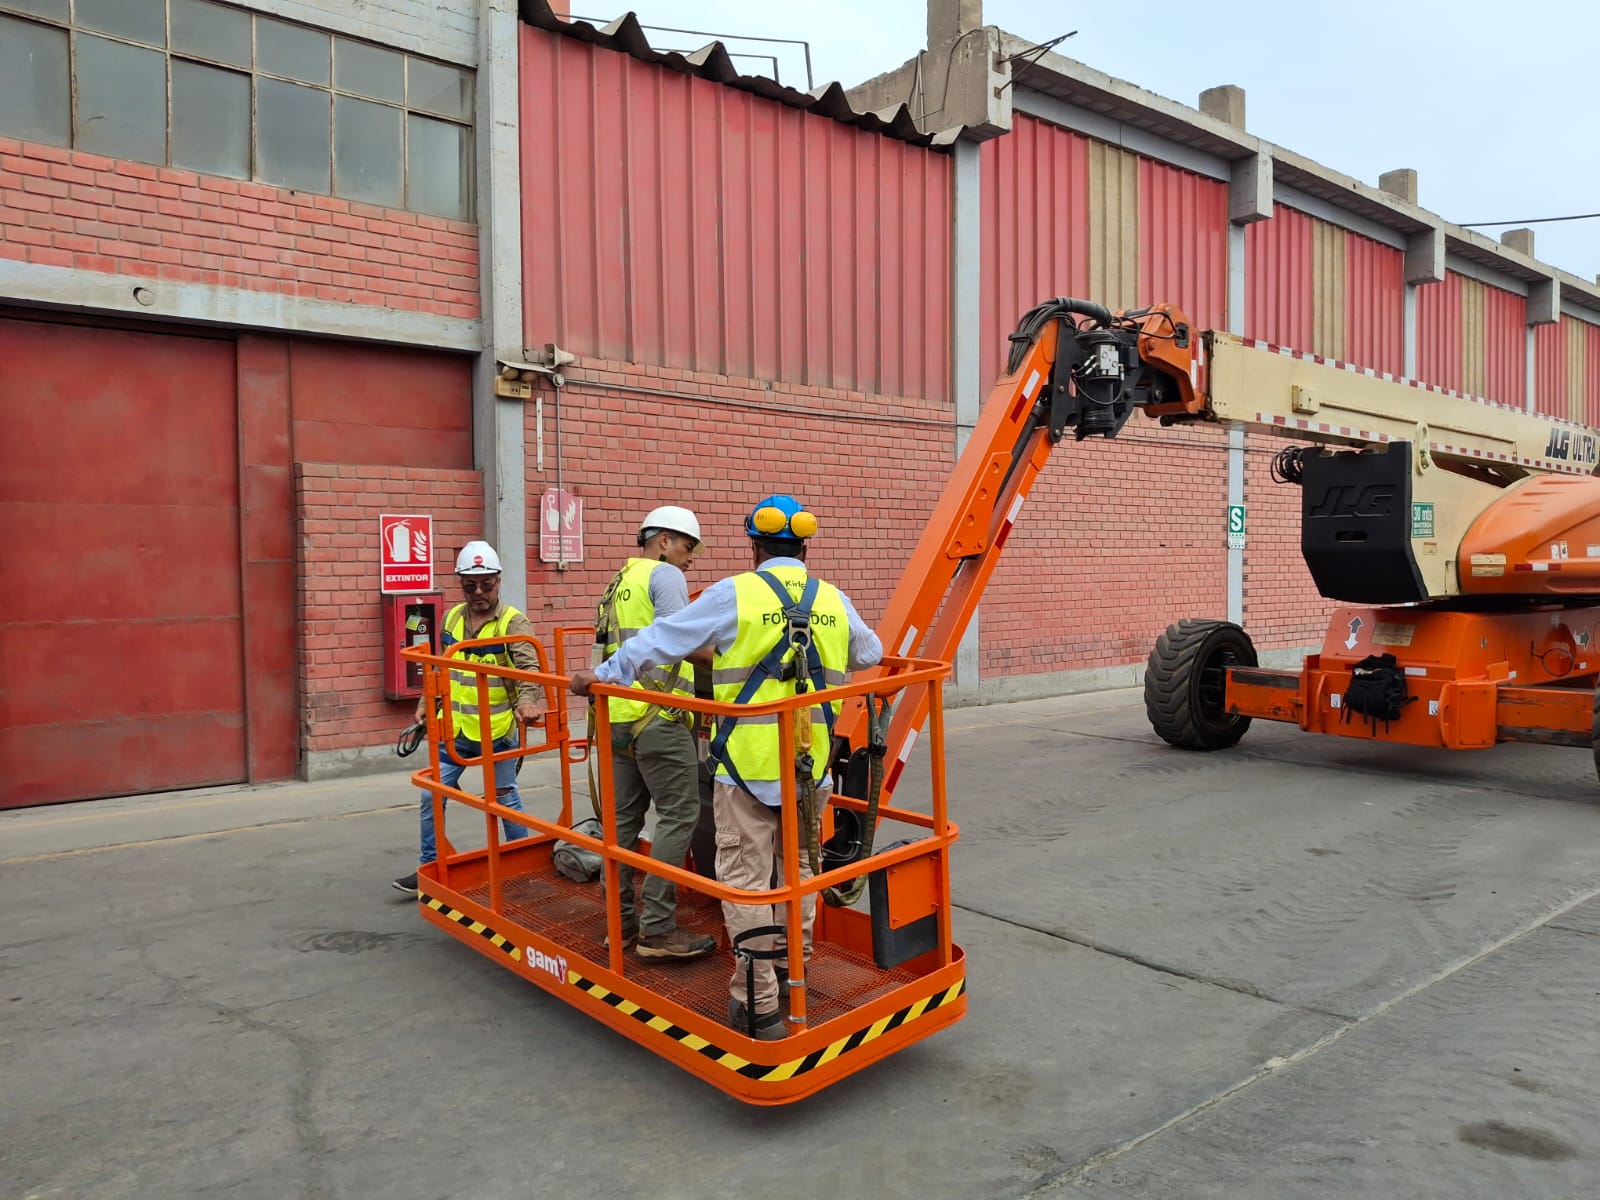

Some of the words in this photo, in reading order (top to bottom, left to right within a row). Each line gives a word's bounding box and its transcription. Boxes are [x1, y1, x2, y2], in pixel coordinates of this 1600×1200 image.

[1545, 428, 1570, 460] JLG
[1572, 433, 1596, 463] ULTRA
[1308, 484, 1398, 517] JLG
[1231, 508, 1242, 531] S
[385, 574, 429, 582] EXTINTOR
[762, 612, 836, 628] FORDOR
